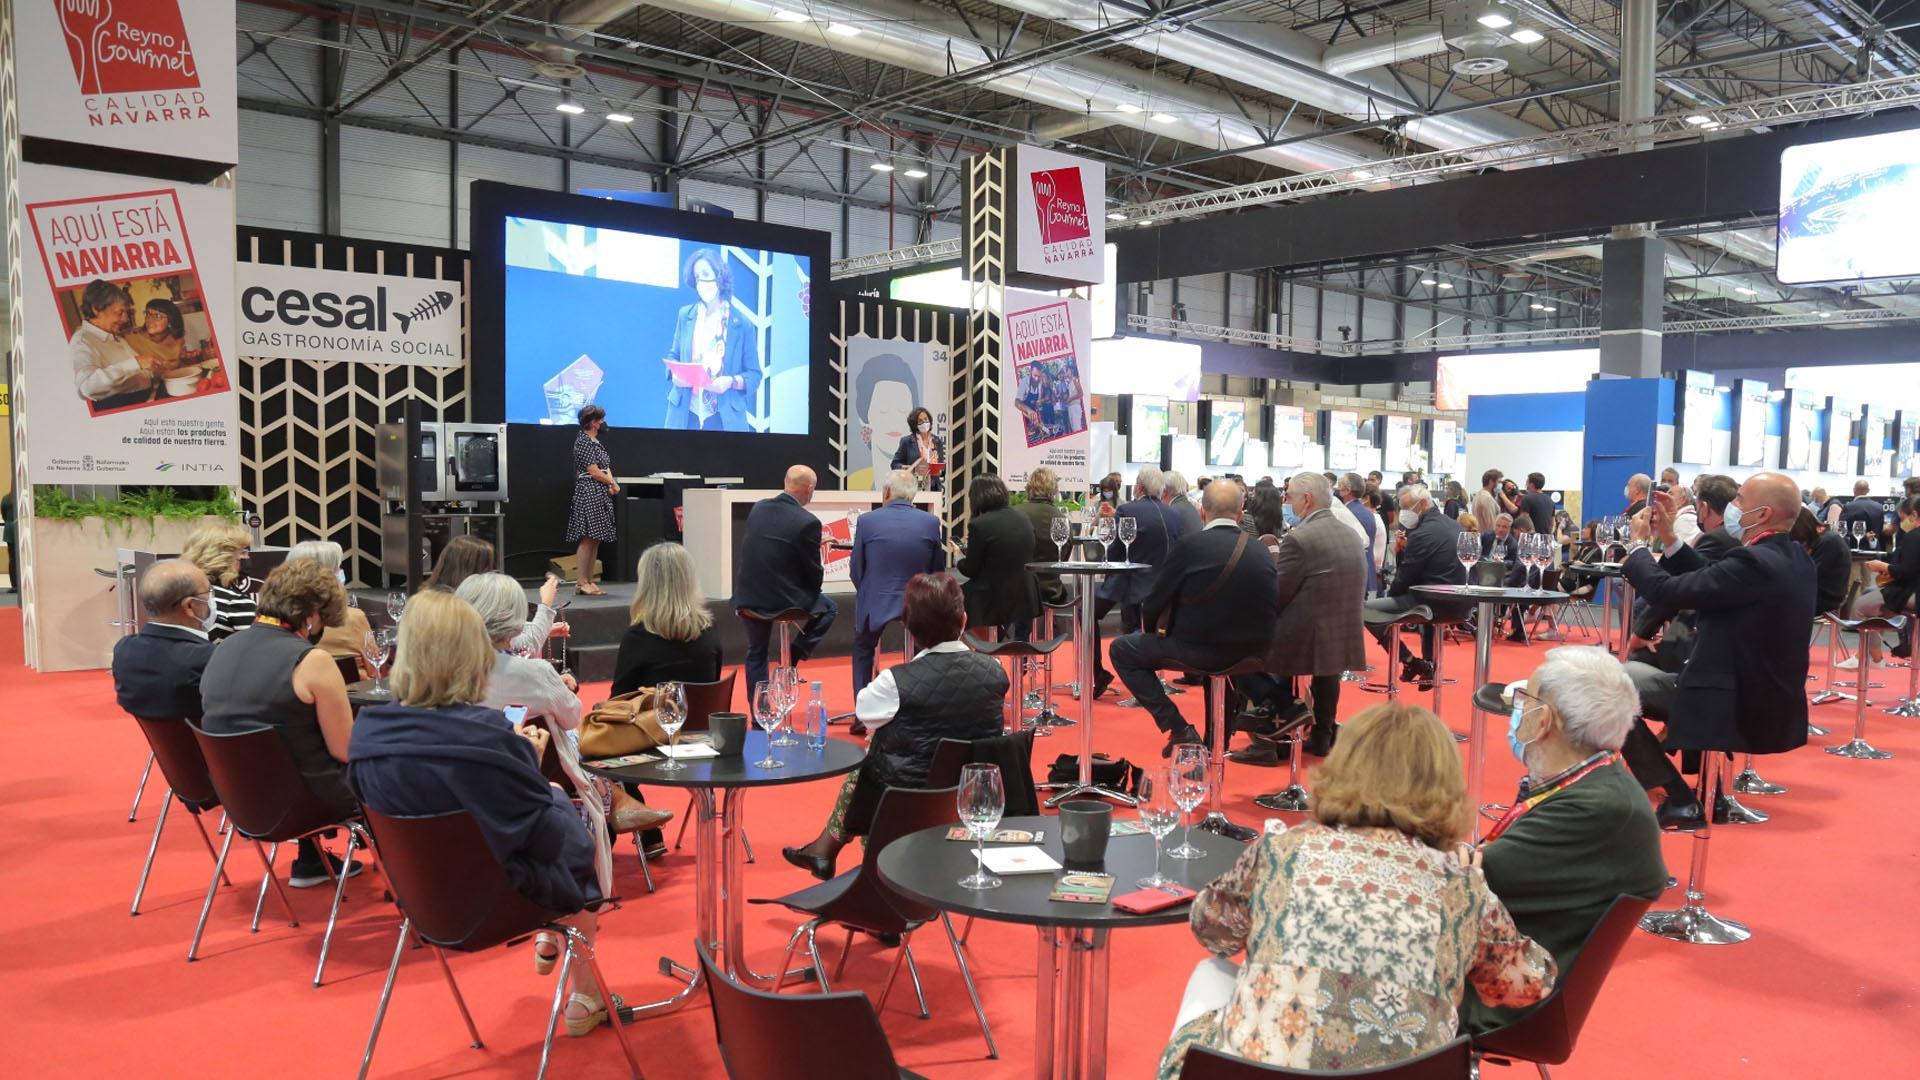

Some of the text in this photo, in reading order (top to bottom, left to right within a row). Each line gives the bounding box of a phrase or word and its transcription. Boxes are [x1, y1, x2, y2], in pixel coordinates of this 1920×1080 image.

[117, 21, 175, 48] Reyno
[98, 29, 195, 77] Gourmet
[84, 91, 205, 112] CALIDAD
[88, 106, 210, 127] NAVARRA
[1056, 197, 1080, 213] Reyno
[51, 199, 171, 247] AQUÍ ESTÁ
[1049, 203, 1088, 230] Gourmet
[1043, 239, 1093, 254] CALIDAD
[1044, 248, 1094, 264] NAVARRA
[55, 238, 182, 279] NAVARRA
[241, 286, 388, 332] cesal
[1015, 308, 1065, 340] AQUÍ ESTÁ
[242, 331, 455, 356] GASTRONOMÍA SOCIAL
[1017, 333, 1069, 361] NAVARRA
[932, 350, 947, 362] 34
[122, 436, 132, 444] de
[133, 436, 161, 445] calidad
[163, 437, 172, 445] de
[174, 438, 201, 446] nuestra
[177, 428, 188, 436] los
[190, 429, 227, 437] productos
[181, 463, 225, 472] INTIA
[1882, 503, 1896, 512] 08
